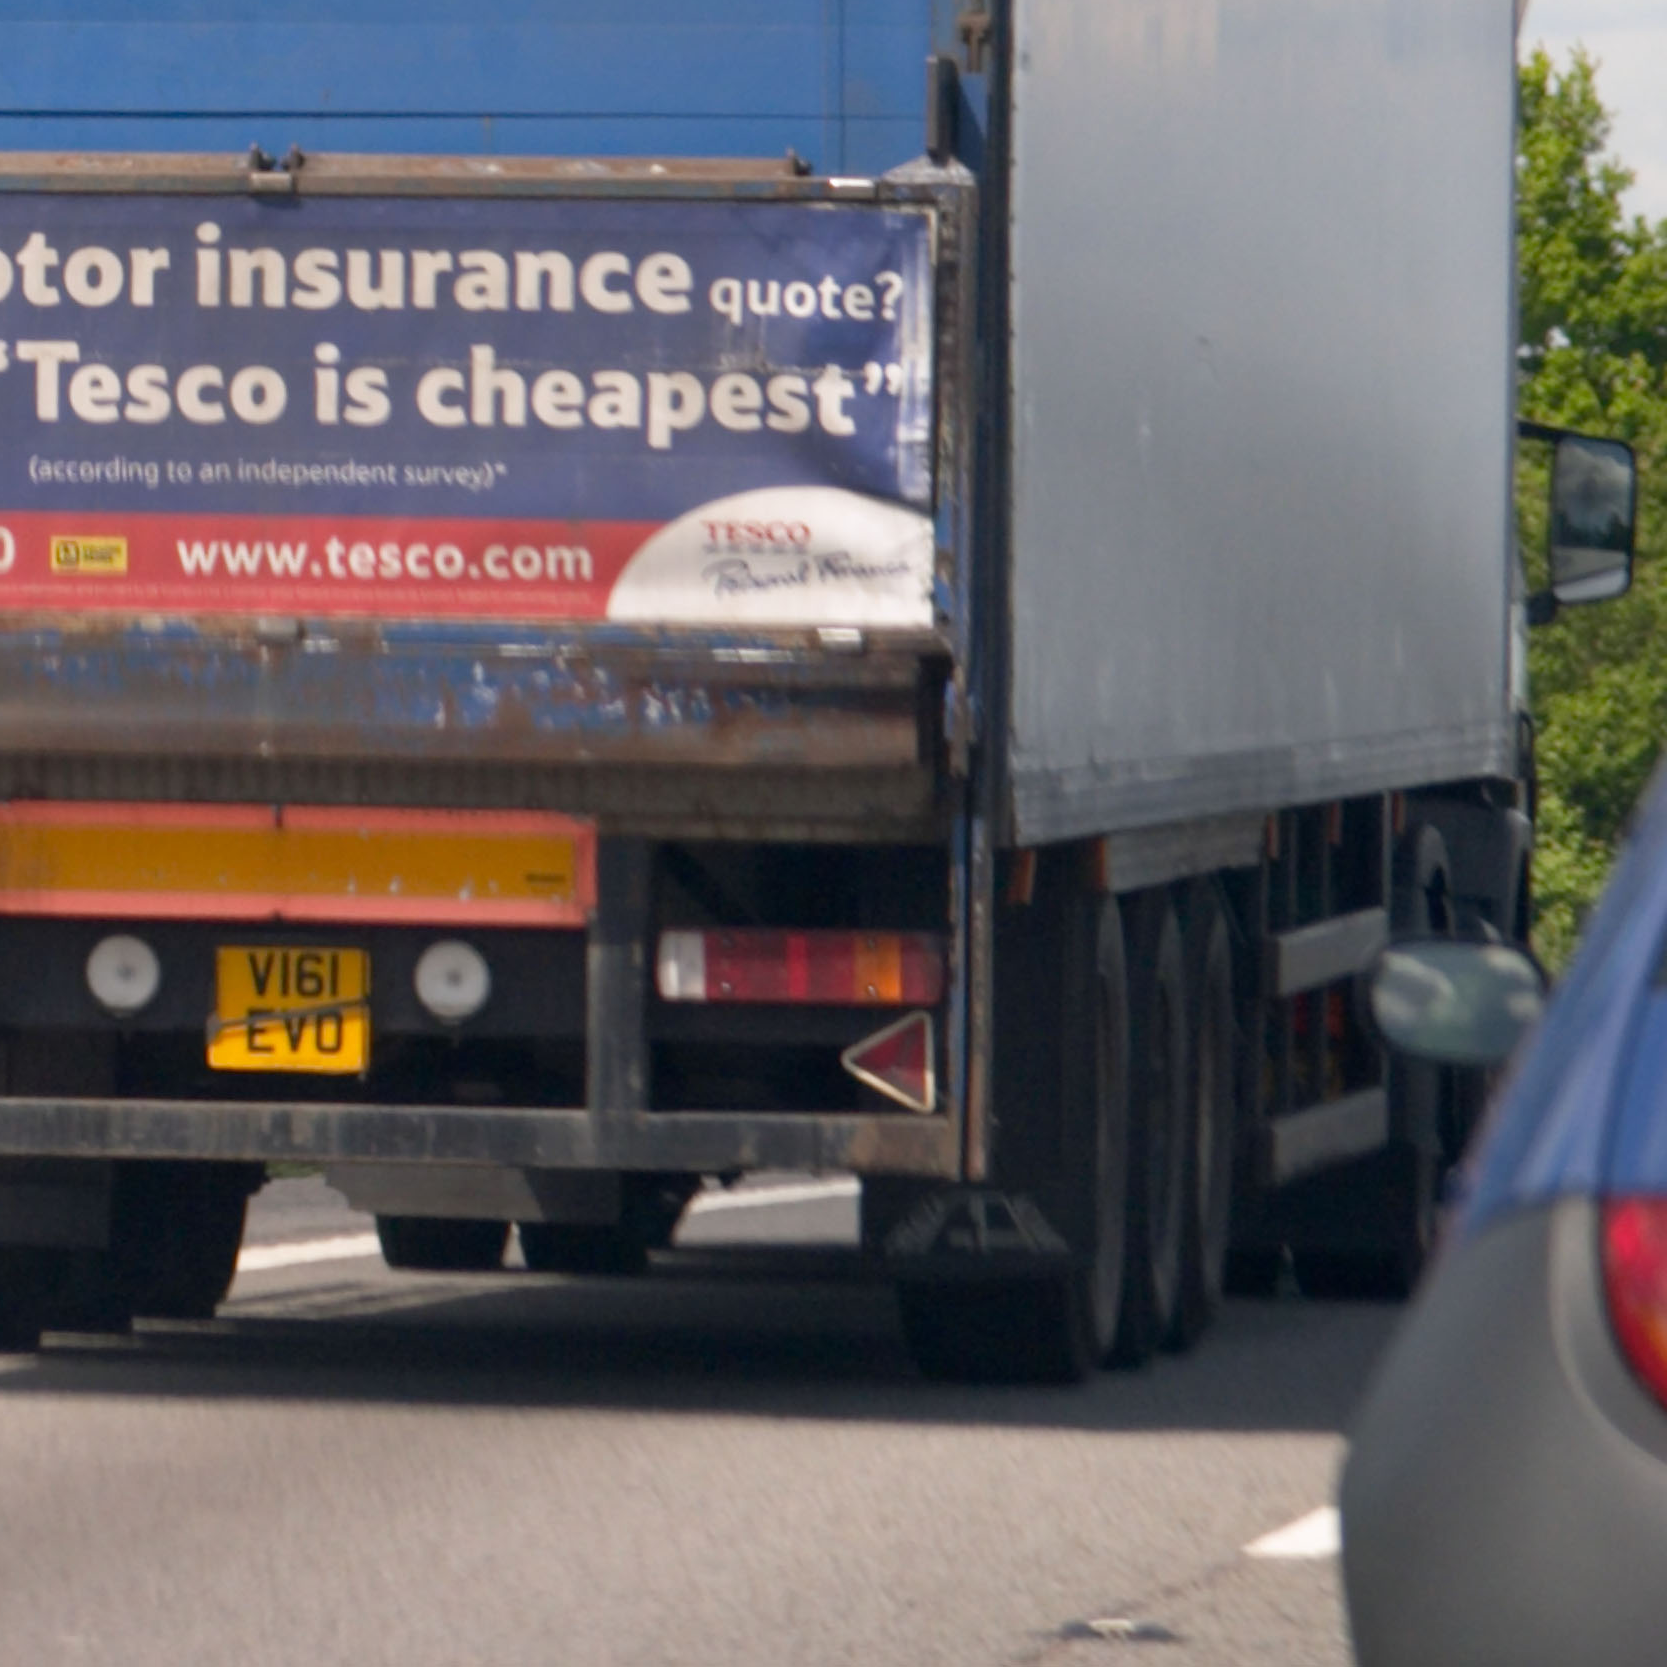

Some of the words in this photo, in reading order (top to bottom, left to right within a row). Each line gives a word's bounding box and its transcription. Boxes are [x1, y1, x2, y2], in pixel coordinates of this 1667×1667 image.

[197, 221, 694, 314] insurance
[709, 270, 903, 325] quote?
[314, 342, 391, 427] is
[416, 343, 902, 449] cheapest”
[29, 456, 159, 488] (according
[168, 458, 192, 484] to
[199, 462, 231, 484] an
[238, 458, 396, 488] independent
[701, 520, 811, 545] TESCO
[177, 535, 592, 582] www.tesco.com
